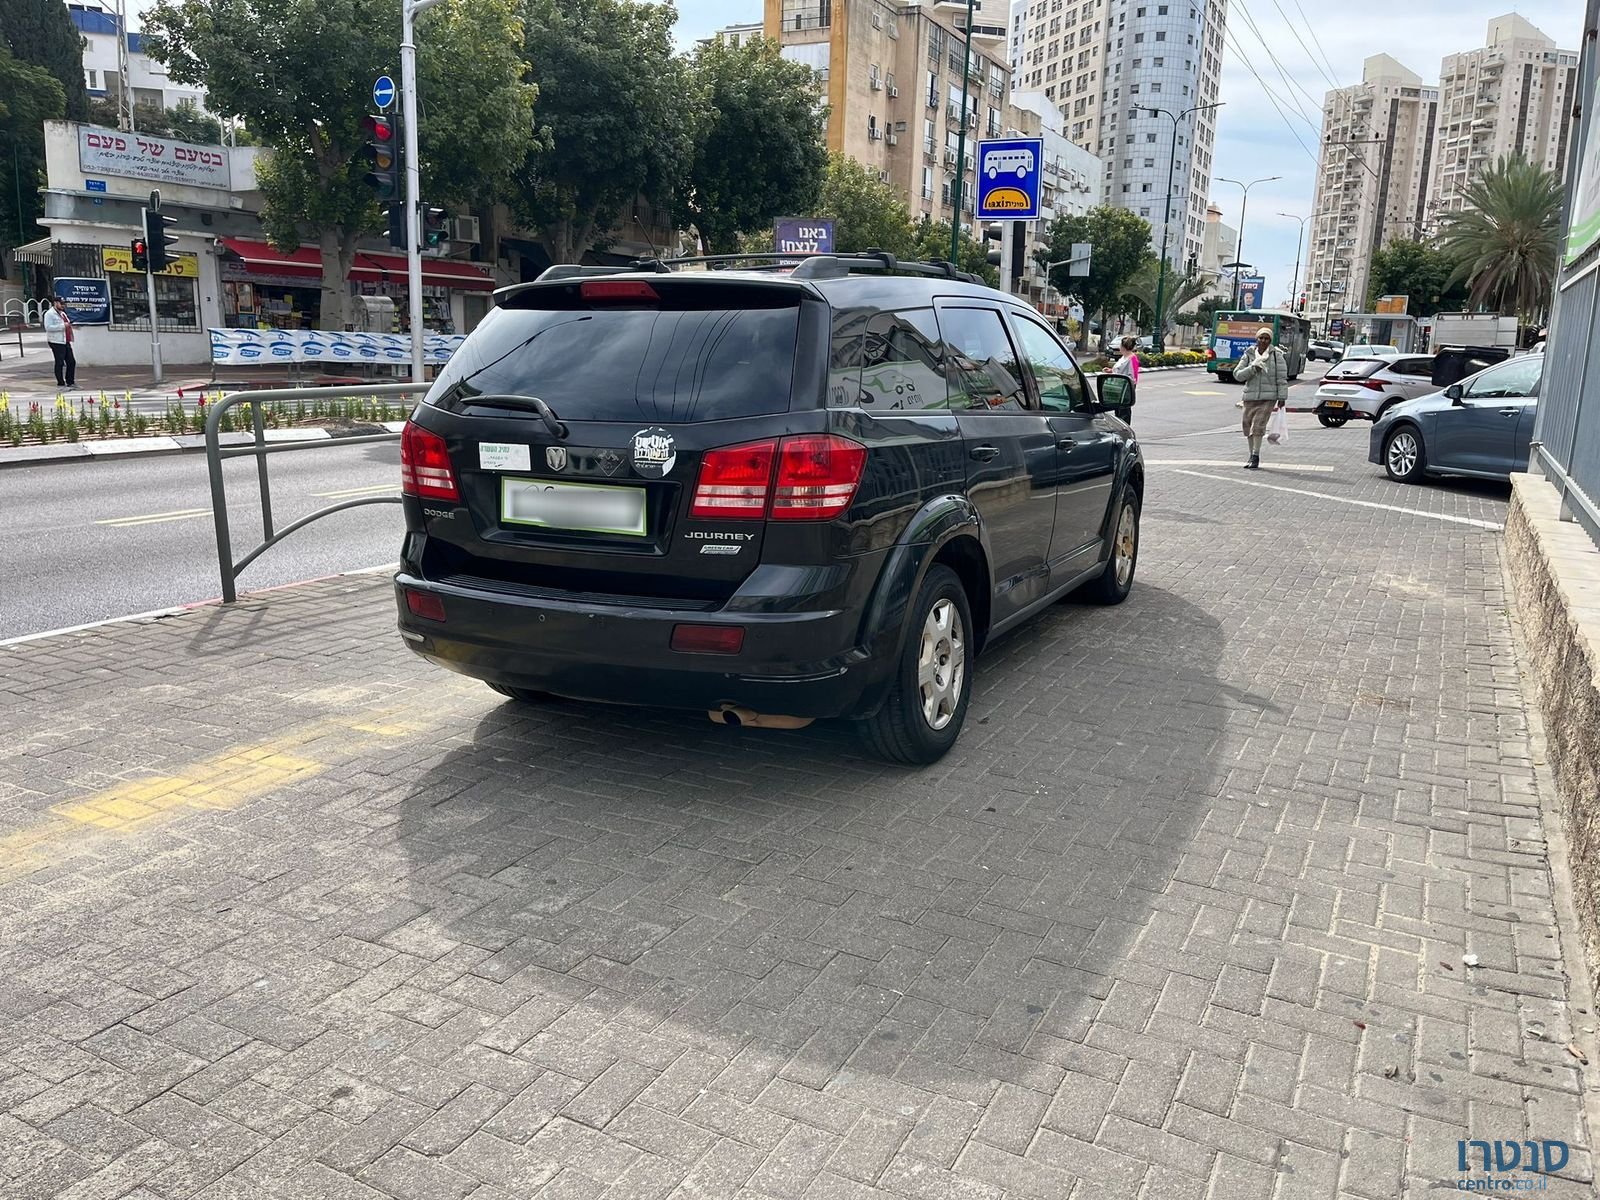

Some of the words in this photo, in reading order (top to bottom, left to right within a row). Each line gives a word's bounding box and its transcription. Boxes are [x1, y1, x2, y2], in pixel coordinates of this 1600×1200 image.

[87, 133, 127, 151] פעם
[136, 137, 165, 157] של
[174, 147, 224, 166] בטעם
[988, 196, 1005, 208] taxi
[799, 227, 828, 239] באנו
[781, 239, 818, 252] לנצח!
[424, 507, 456, 520] DODGE
[684, 531, 755, 541] JOURNEY
